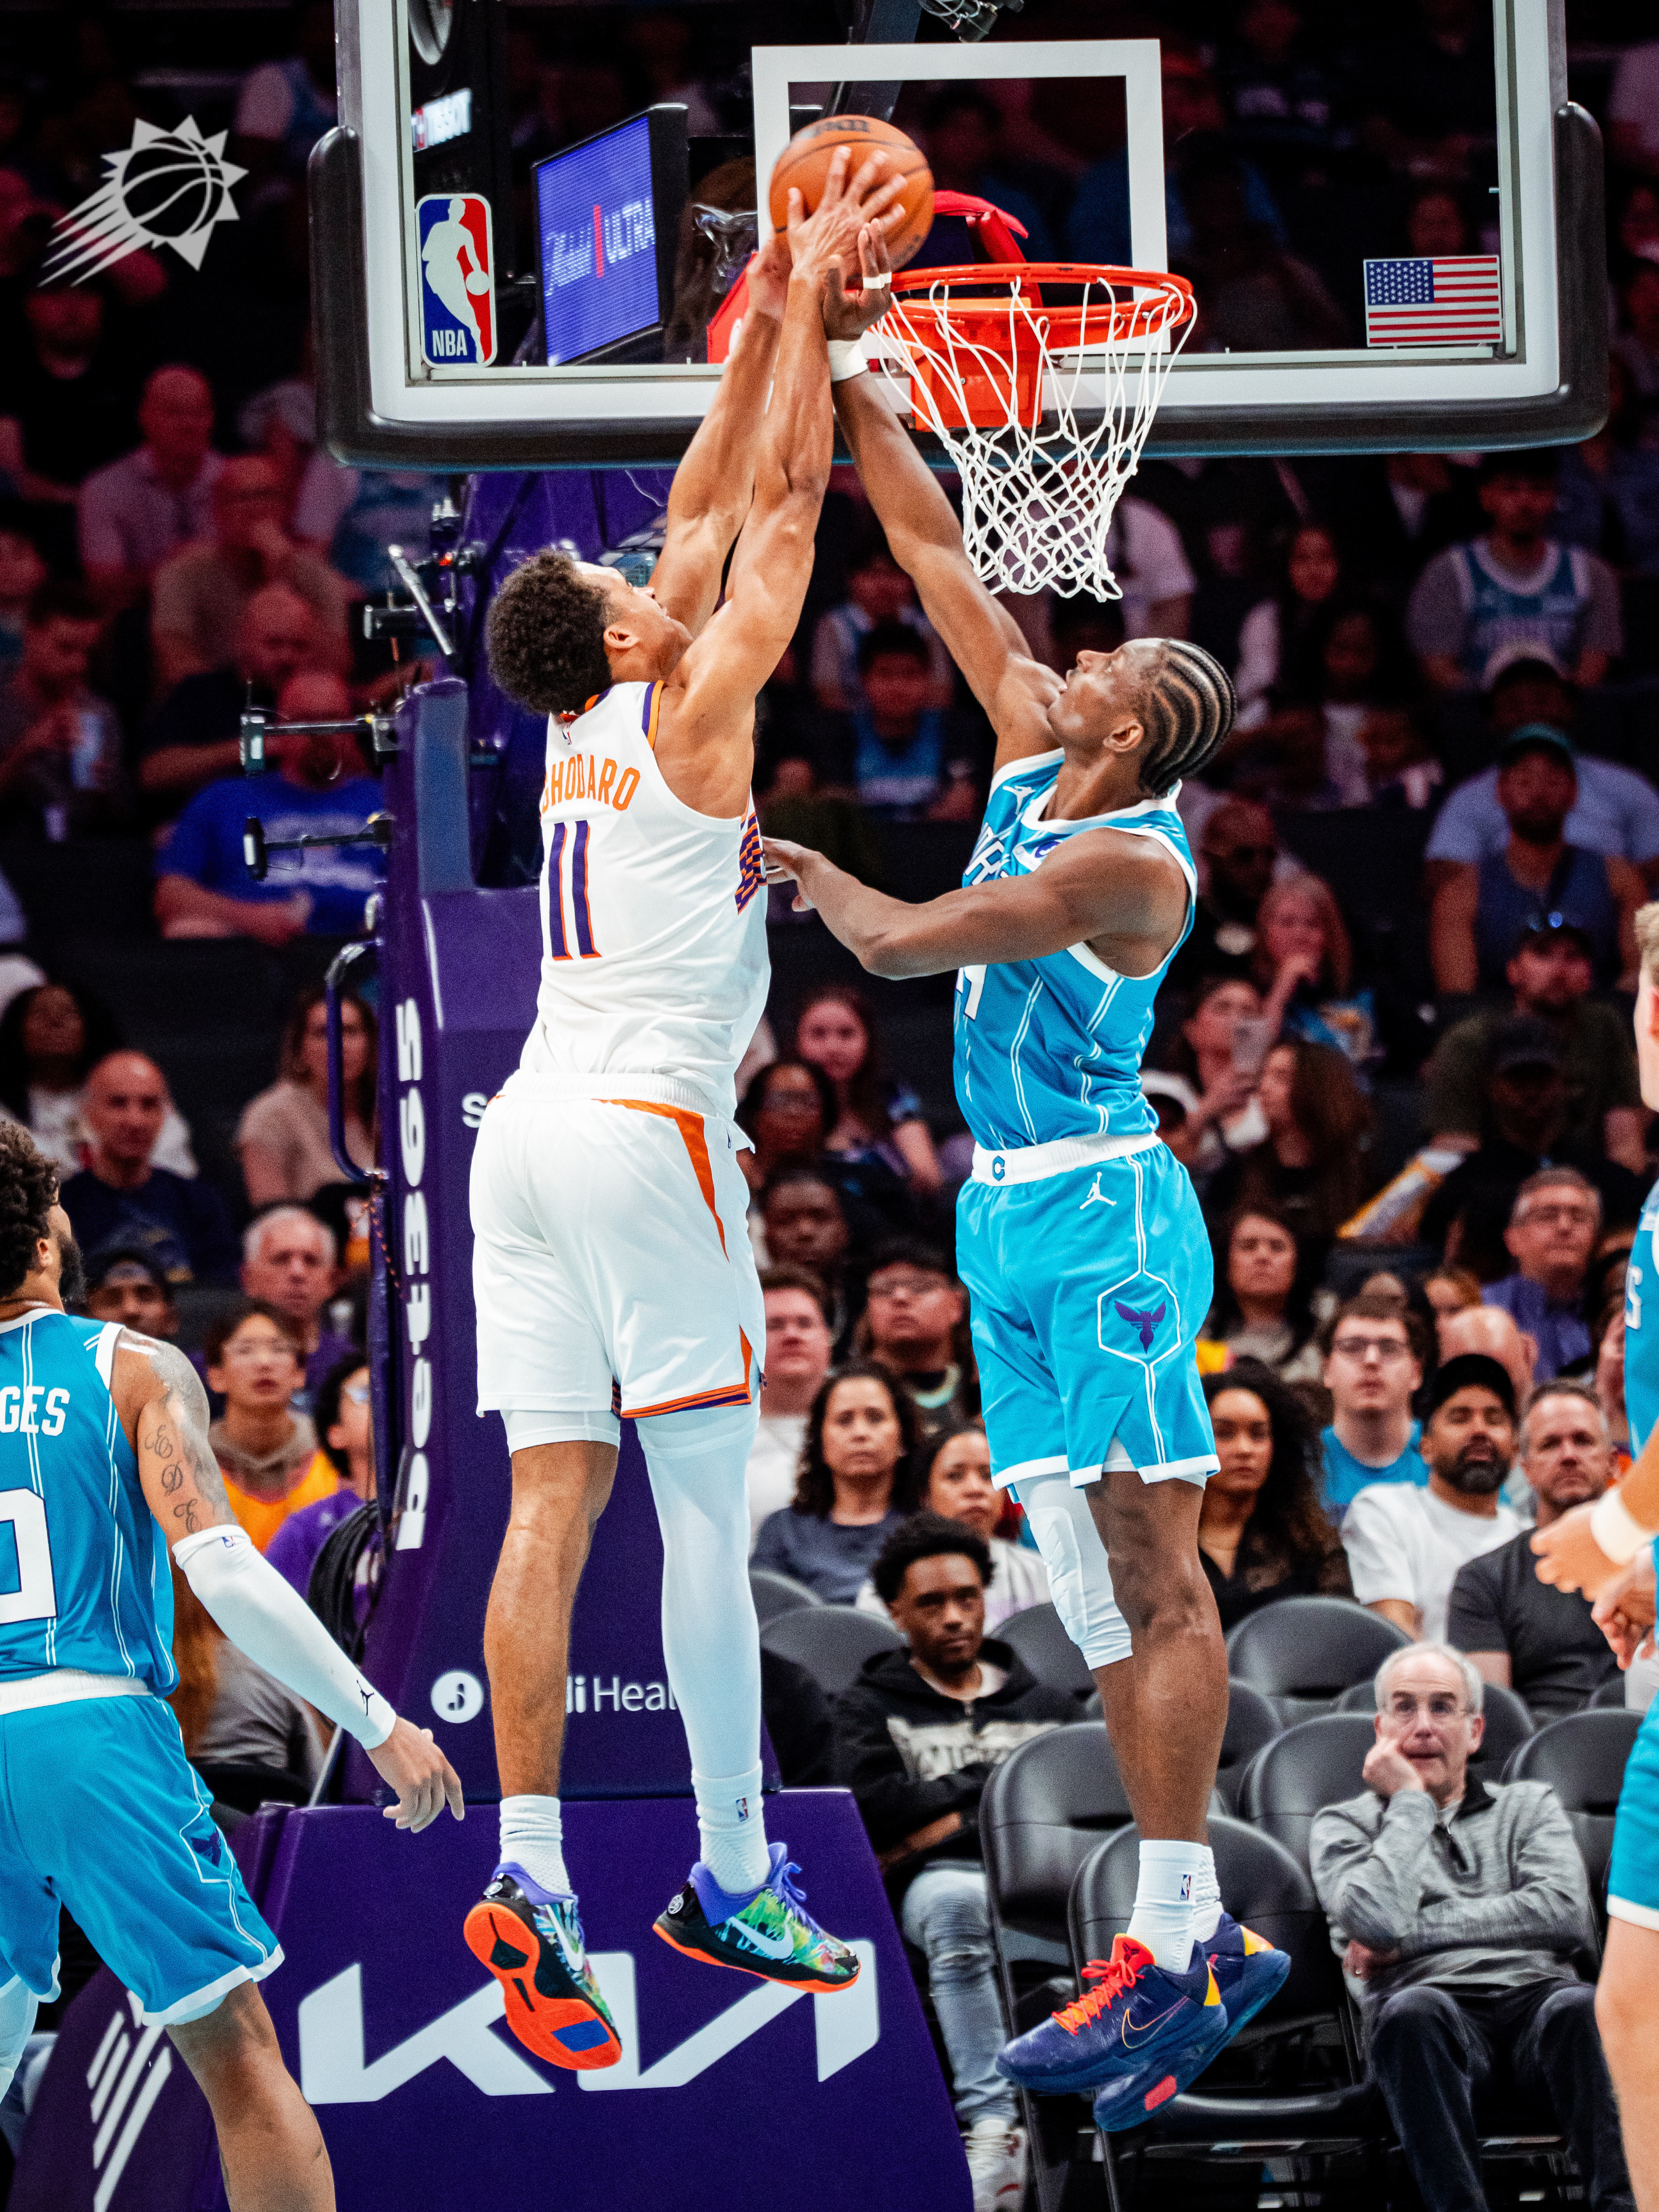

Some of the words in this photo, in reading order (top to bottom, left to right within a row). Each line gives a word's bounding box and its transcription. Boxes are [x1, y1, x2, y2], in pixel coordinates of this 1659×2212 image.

[432, 329, 468, 357] NBA
[548, 819, 603, 961] 11
[396, 998, 432, 1550] bet365
